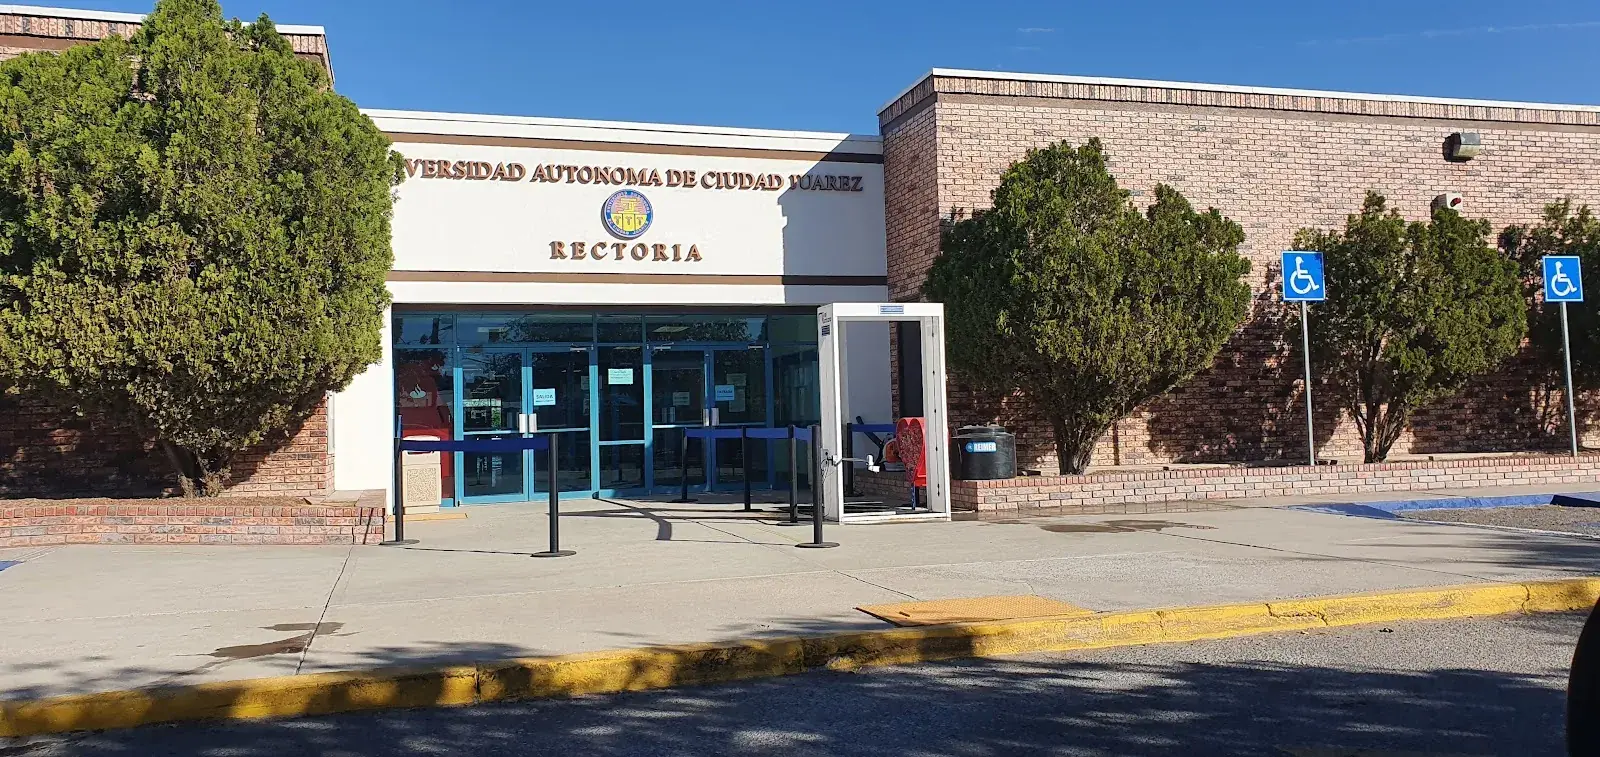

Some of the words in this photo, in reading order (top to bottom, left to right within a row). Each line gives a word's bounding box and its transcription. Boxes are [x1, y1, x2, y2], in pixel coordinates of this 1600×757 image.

[404, 159, 526, 182] VERSIDAD
[530, 163, 662, 187] AUTONOMA
[665, 169, 697, 188] DE
[700, 170, 785, 191] CIUDAD
[788, 174, 864, 191] JUAREZ
[549, 241, 702, 262] RECTORIA
[973, 442, 996, 452] REIMER
